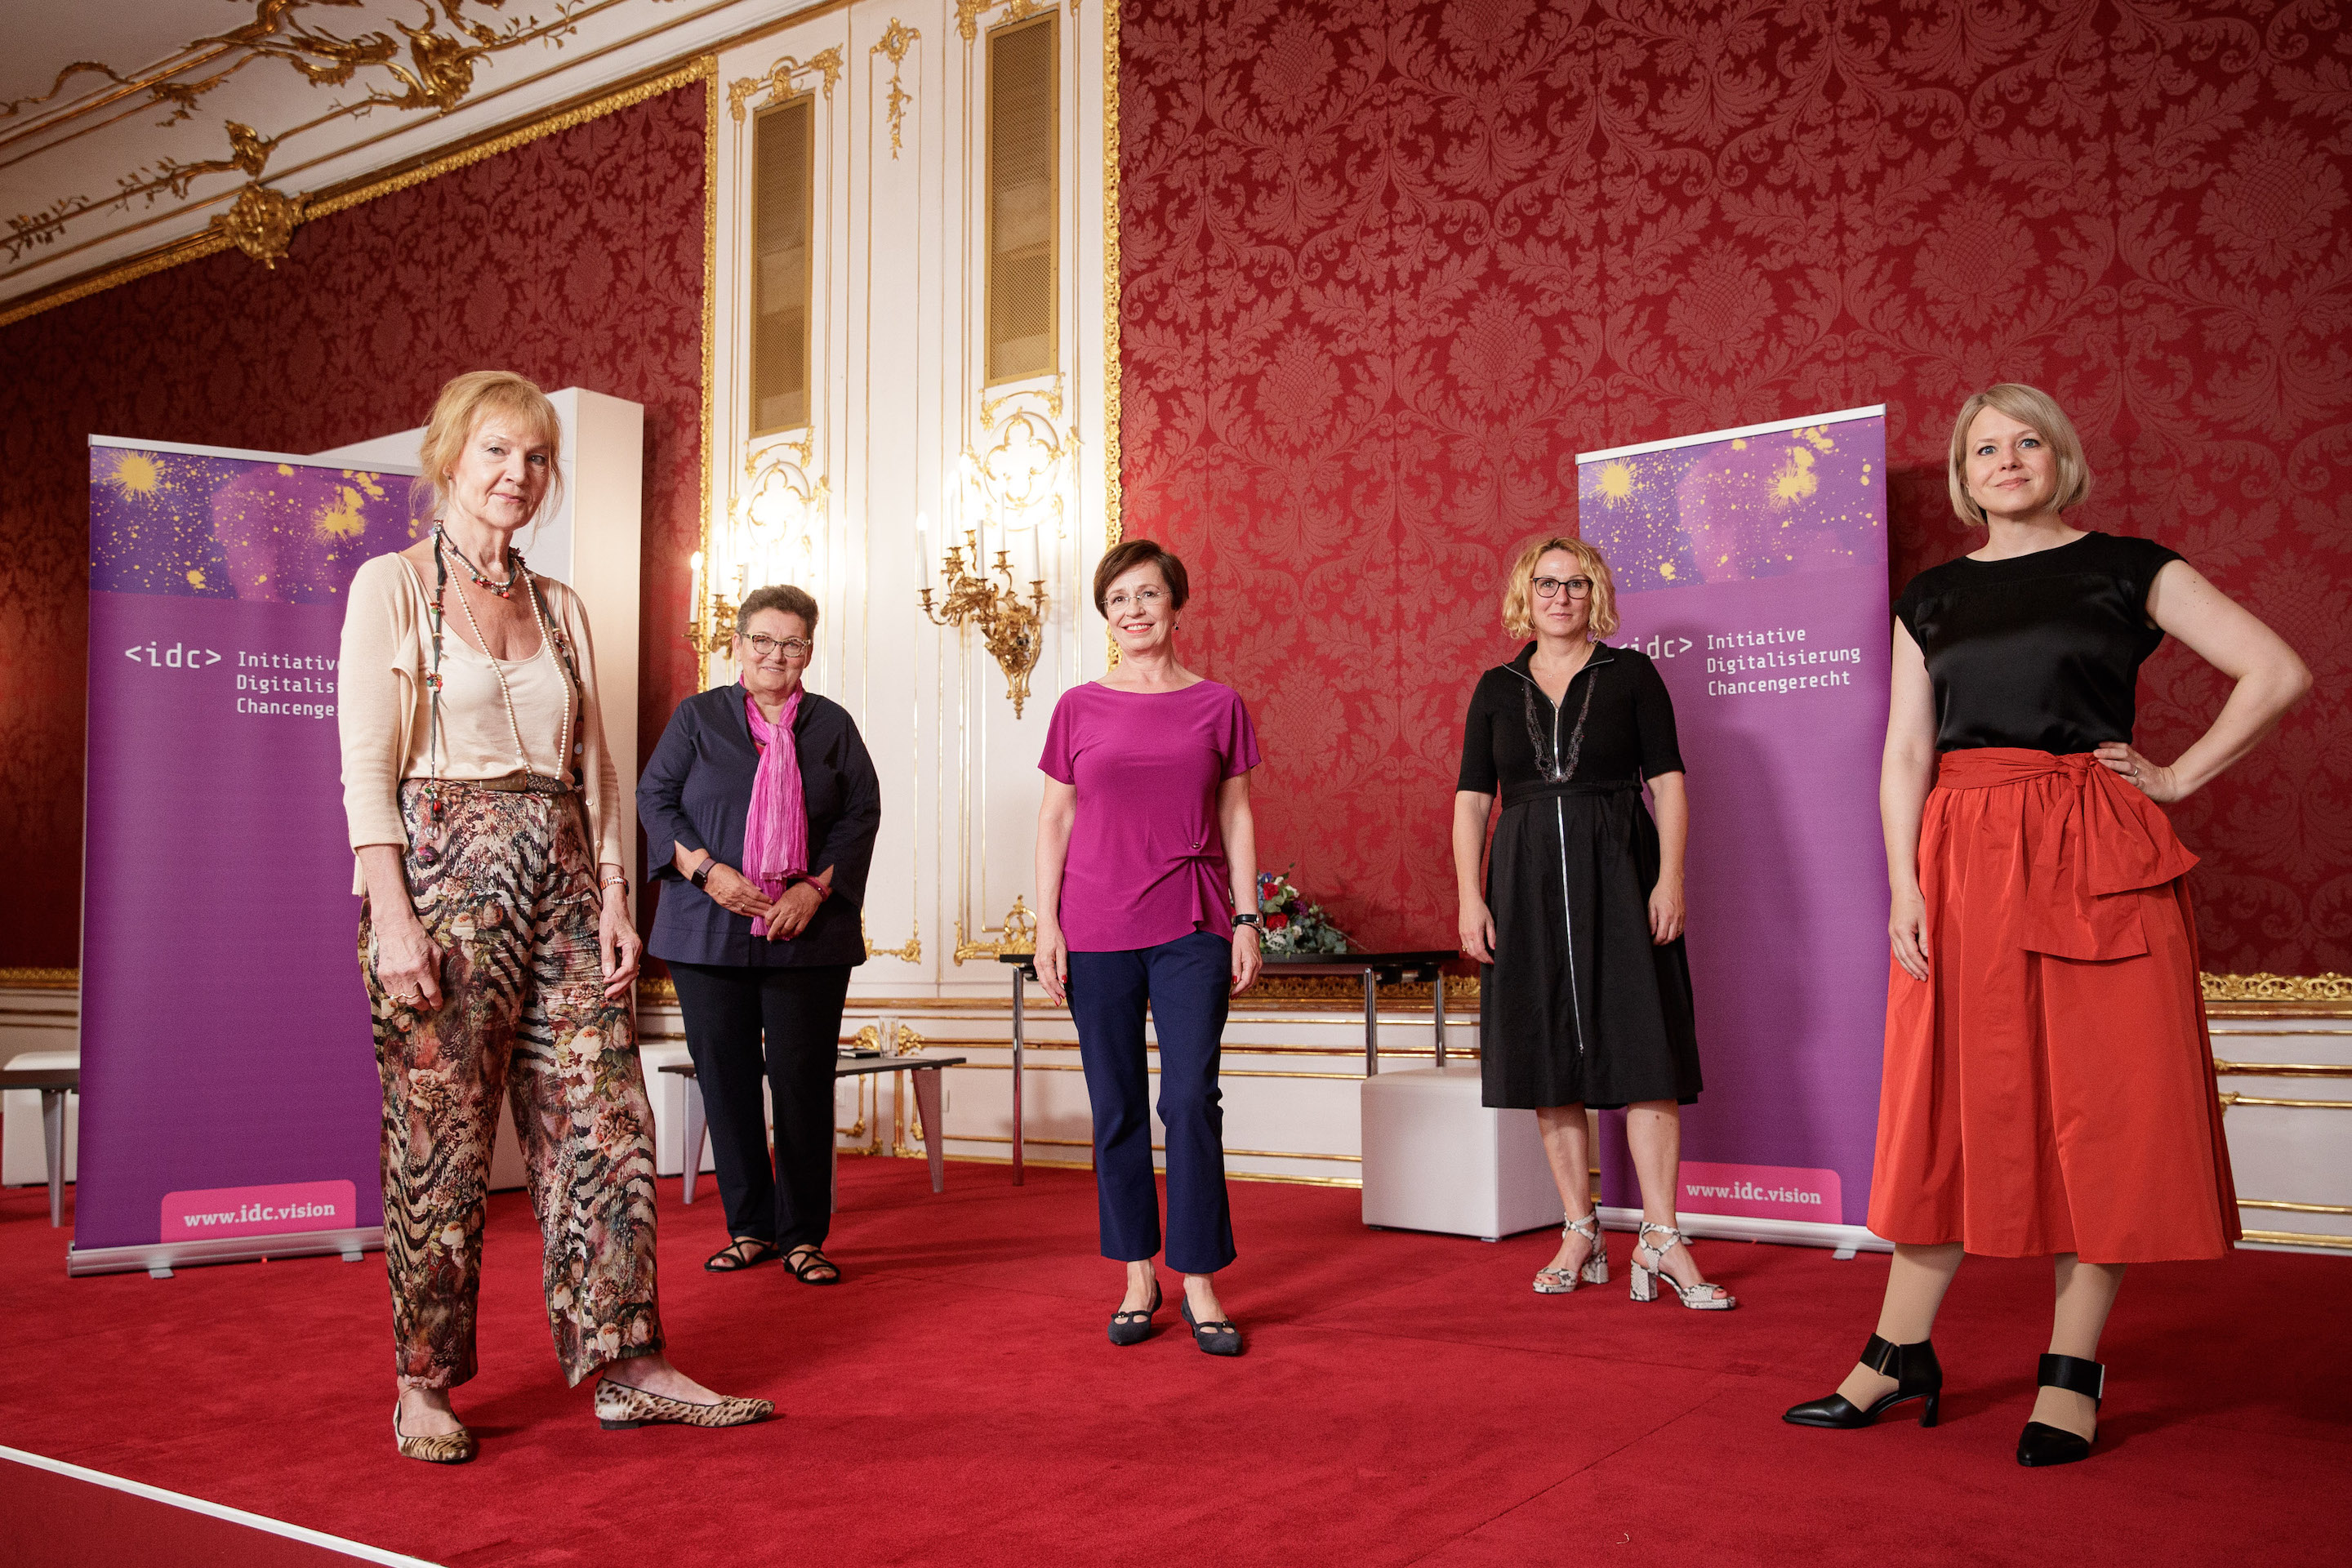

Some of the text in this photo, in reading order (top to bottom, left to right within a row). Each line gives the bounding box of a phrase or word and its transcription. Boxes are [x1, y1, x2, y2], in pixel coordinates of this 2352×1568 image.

[1707, 628, 1806, 651] Initiative
[125, 641, 222, 669] <idc>
[238, 651, 340, 671] Initiativ
[1707, 648, 1861, 675] Digitalisierung
[237, 674, 339, 694] Digitalis
[1708, 670, 1851, 697] Chancengerecht
[237, 697, 339, 719] Chancenge
[1686, 1181, 1822, 1205] www.idc.vision
[183, 1202, 336, 1228] www.idc.vision
